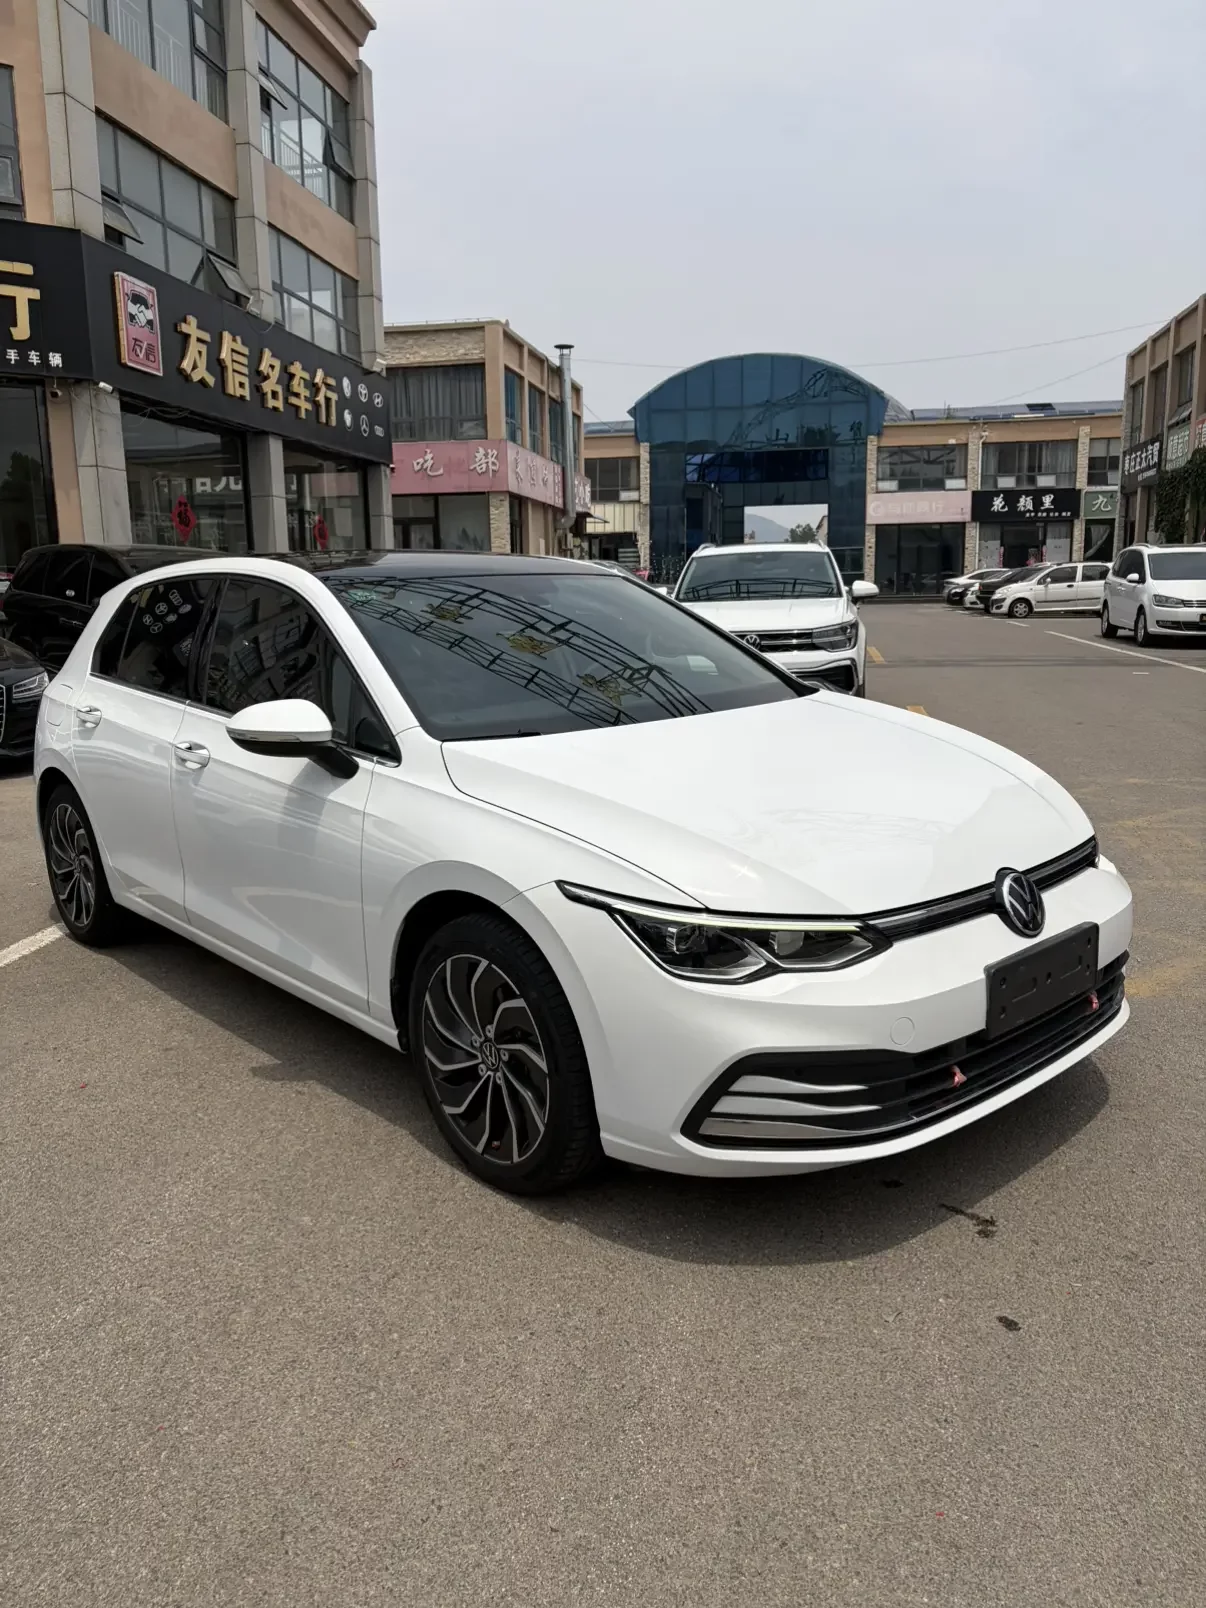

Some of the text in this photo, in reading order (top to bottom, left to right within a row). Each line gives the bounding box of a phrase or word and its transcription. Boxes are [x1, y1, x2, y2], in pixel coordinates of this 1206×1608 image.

[6, 349, 63, 368] 手车辆
[131, 337, 156, 363] 友信
[177, 315, 338, 427] 友信名车行
[413, 446, 500, 478] 吃部
[990, 493, 1055, 512] 花颜里
[1091, 495, 1112, 511] 九
